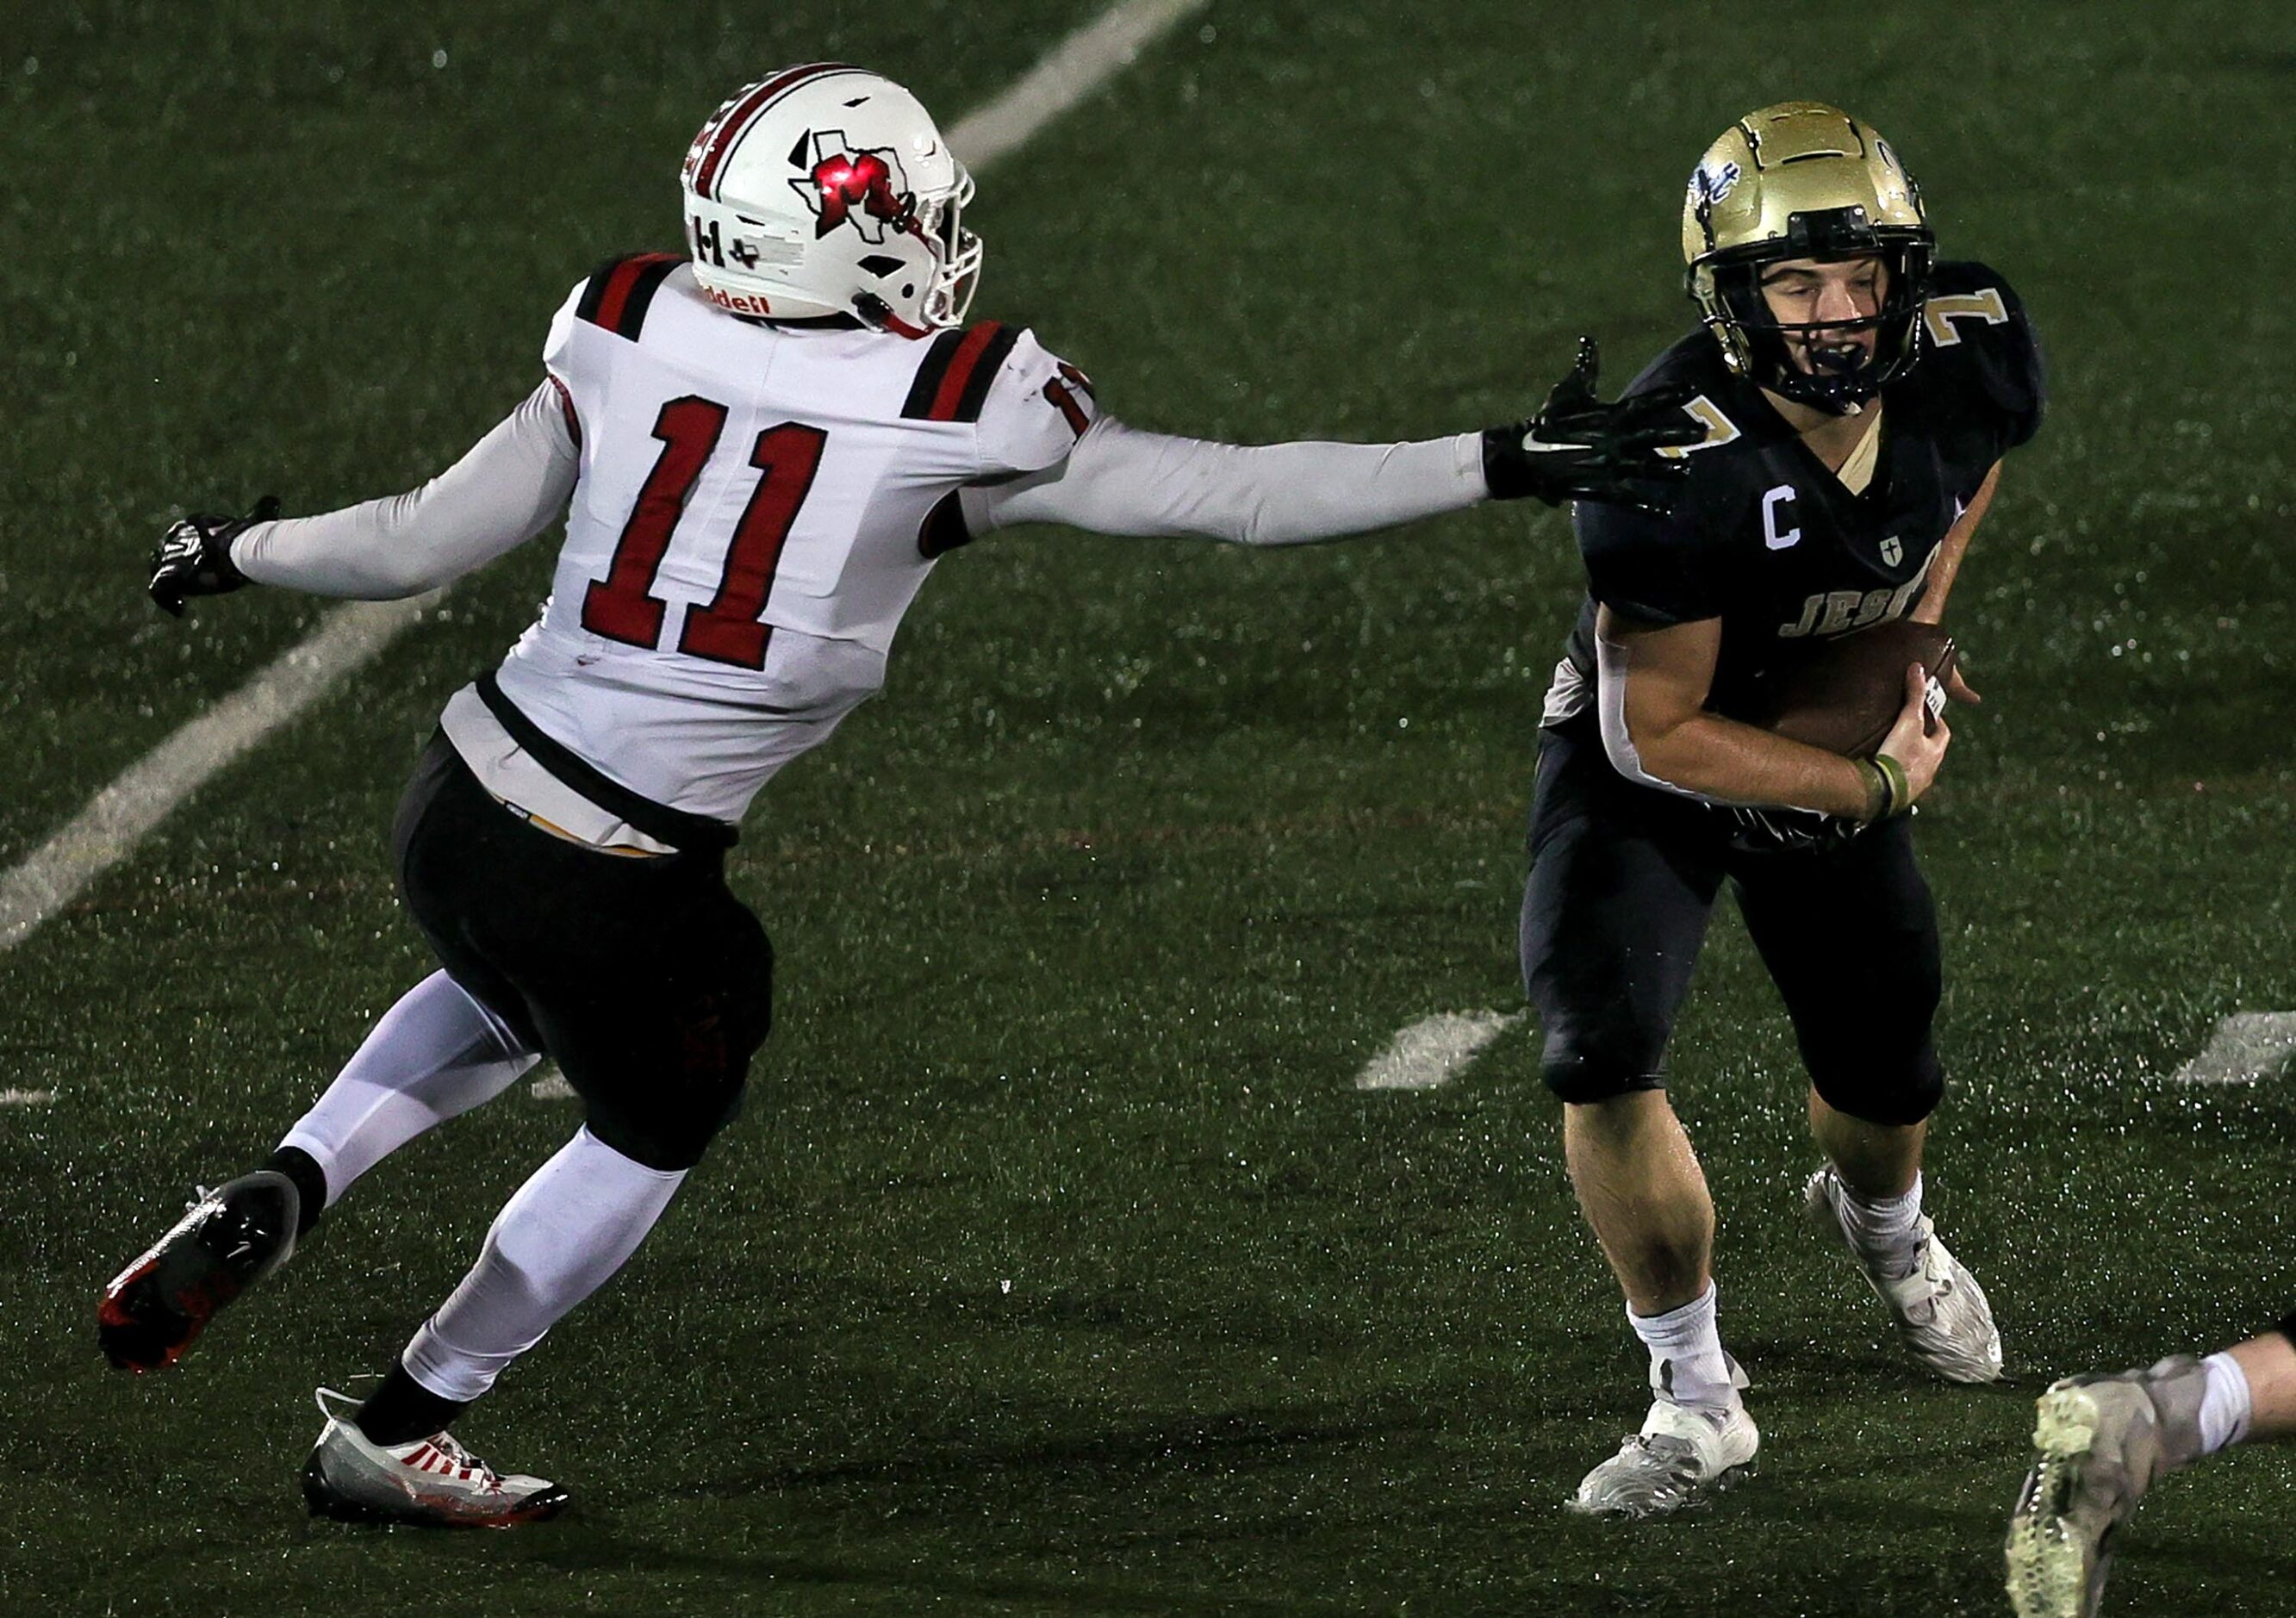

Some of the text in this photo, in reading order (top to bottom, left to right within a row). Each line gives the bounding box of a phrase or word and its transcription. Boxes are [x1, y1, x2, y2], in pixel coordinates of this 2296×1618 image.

[704, 285, 769, 314] ddell
[1924, 288, 2009, 347] 7
[1652, 395, 1741, 458] 7
[581, 395, 829, 672] 11
[1763, 484, 1801, 551] C
[1778, 562, 1928, 638] JES
